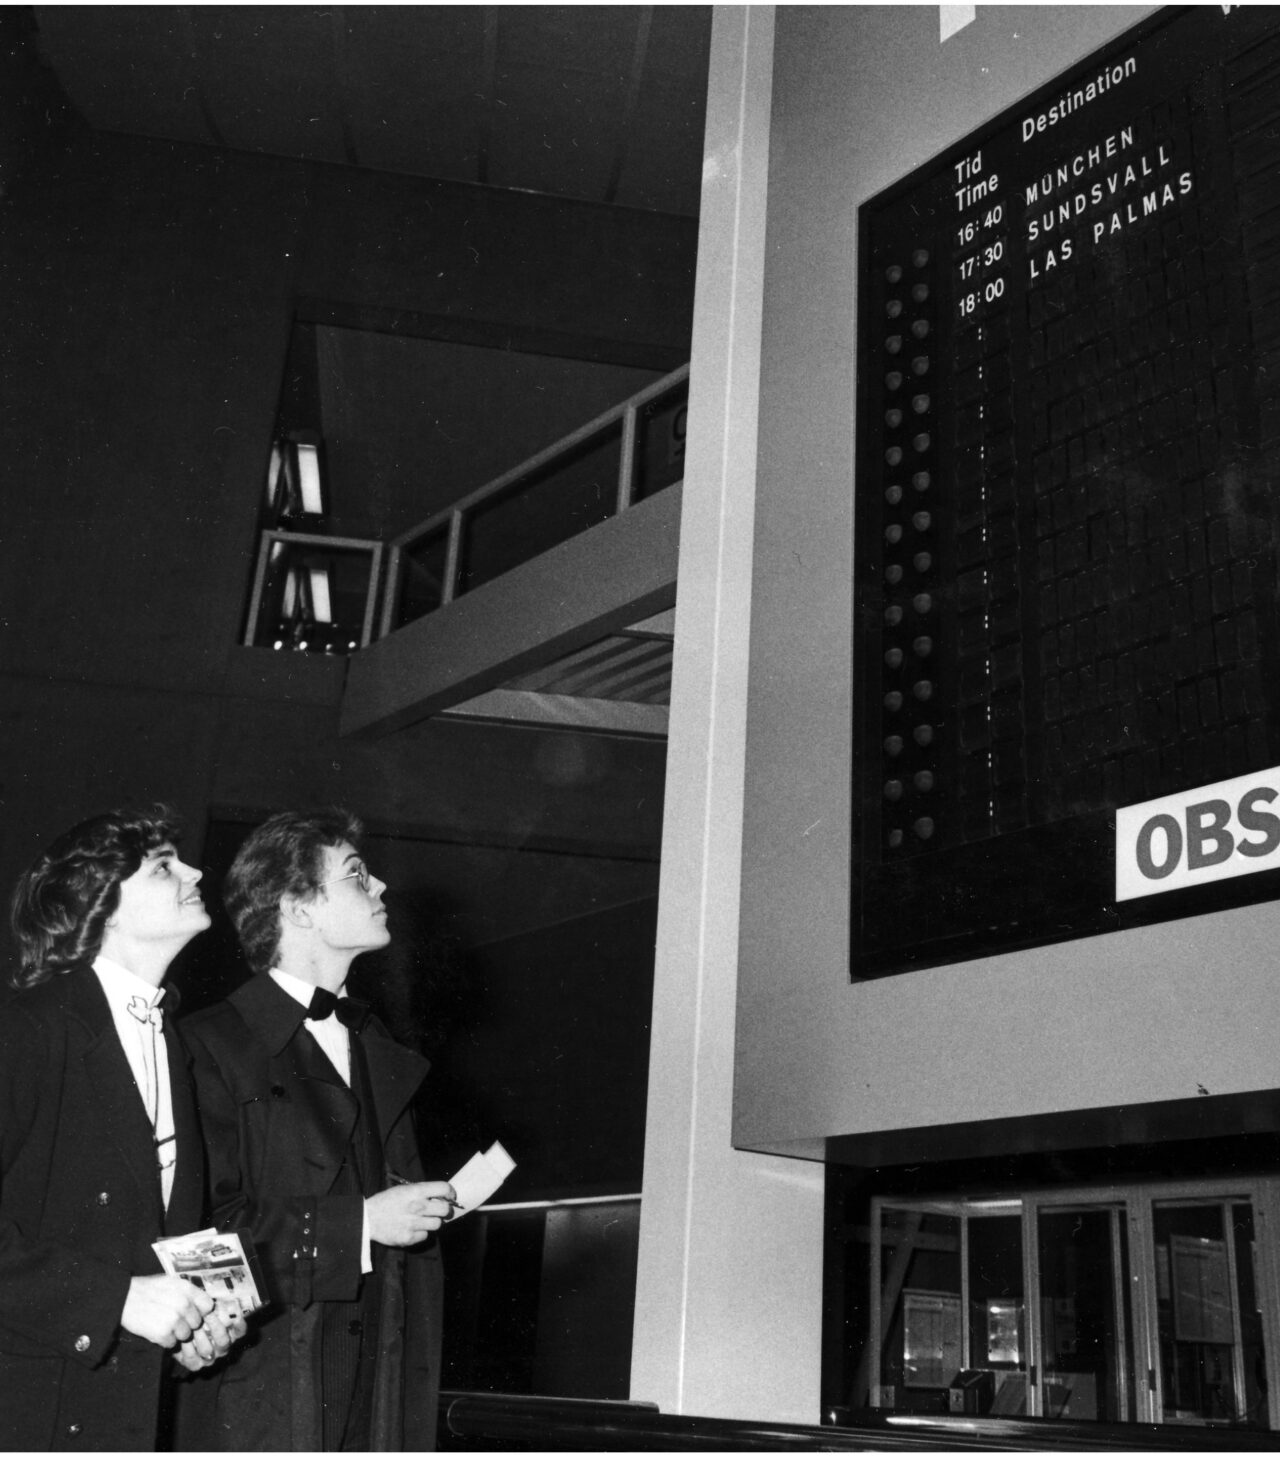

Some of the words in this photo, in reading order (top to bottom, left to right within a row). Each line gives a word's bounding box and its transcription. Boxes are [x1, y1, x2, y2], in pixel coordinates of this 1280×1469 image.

[1021, 56, 1137, 142] Destination
[954, 150, 982, 185] Tid
[955, 172, 1000, 213] Time
[958, 205, 1002, 247] 16:40
[959, 241, 1003, 281] 17:30
[1028, 144, 1170, 242] SUNDSVALL
[958, 277, 1004, 318] 18:00
[1030, 239, 1073, 279] LAS
[1094, 172, 1193, 243] PALMAS
